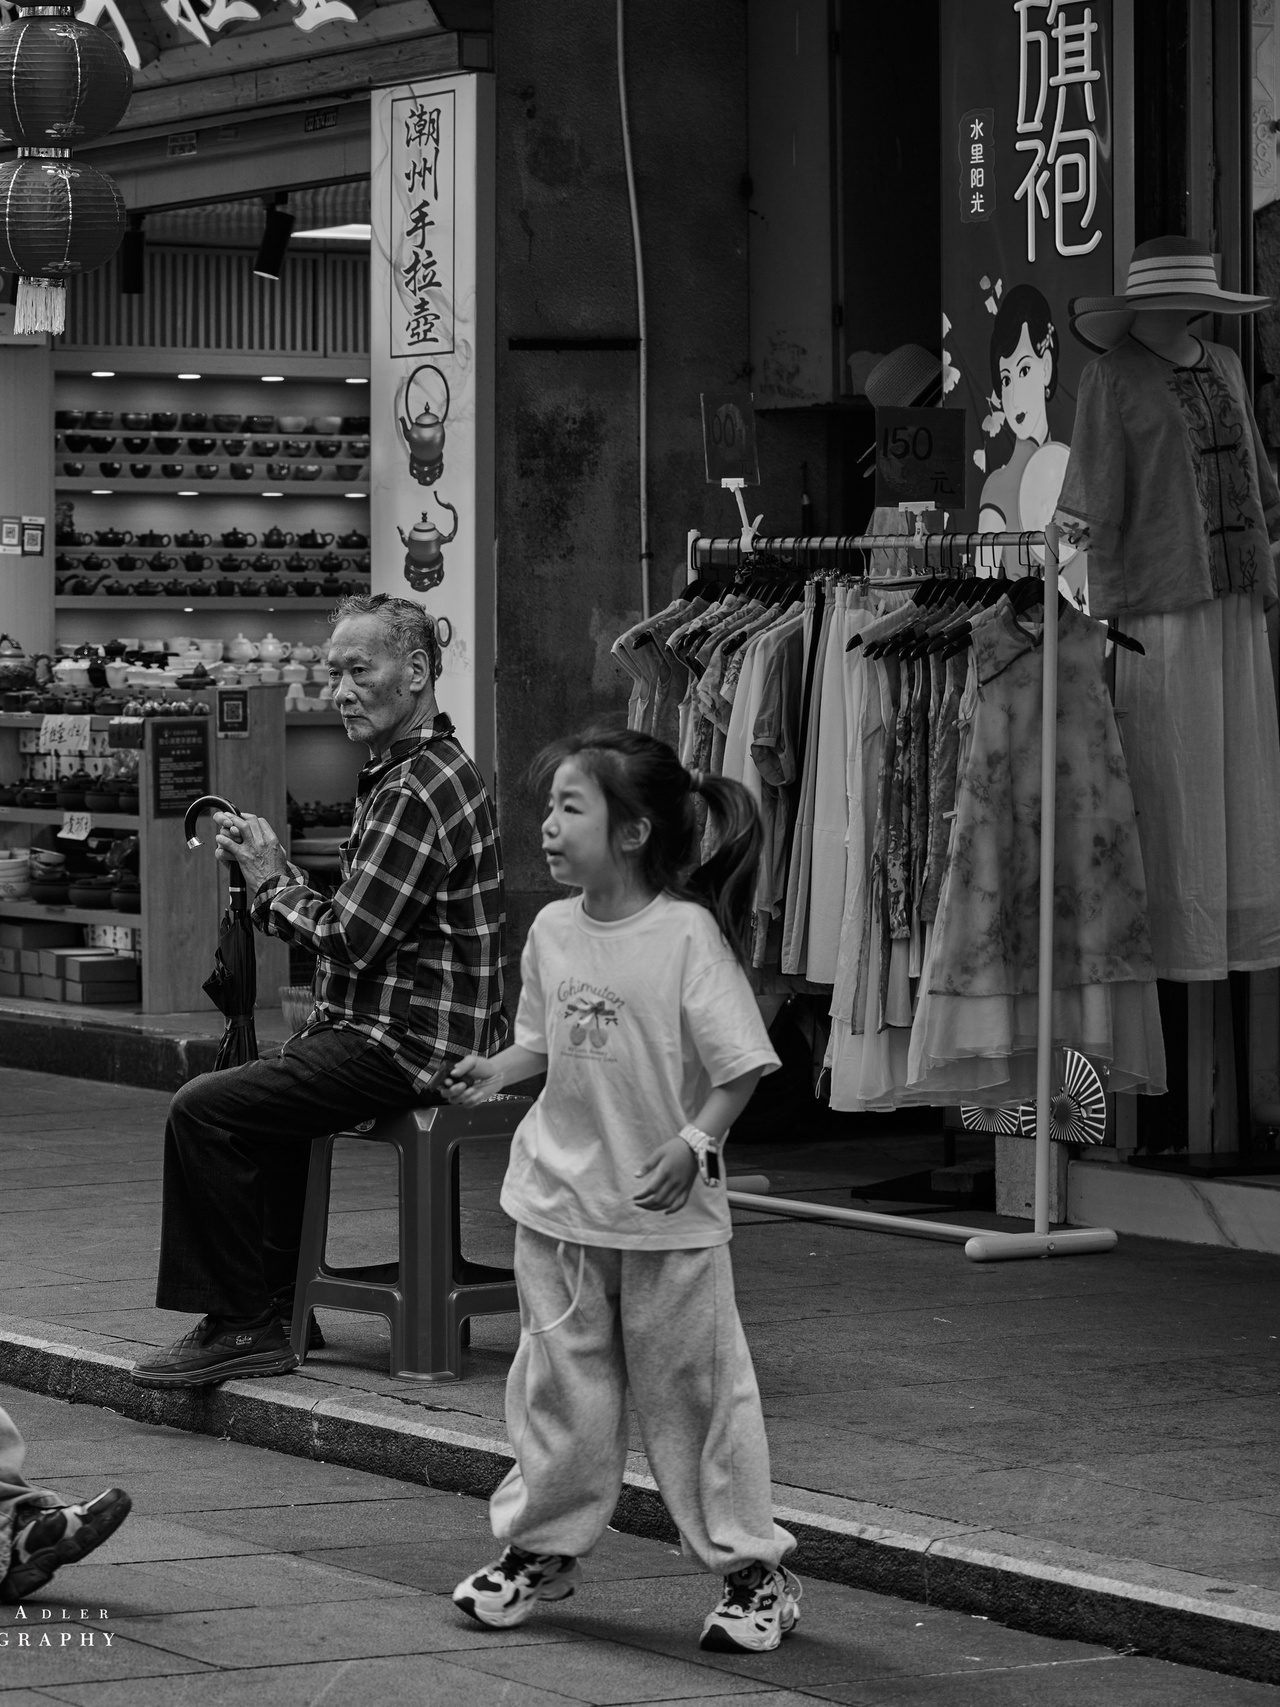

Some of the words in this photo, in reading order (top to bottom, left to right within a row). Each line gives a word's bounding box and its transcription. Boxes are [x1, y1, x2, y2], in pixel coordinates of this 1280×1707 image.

[1014, 0, 1102, 262] 旗袍
[969, 118, 985, 214] 水里阳光
[882, 425, 933, 461] 150
[930, 471, 956, 495] 元
